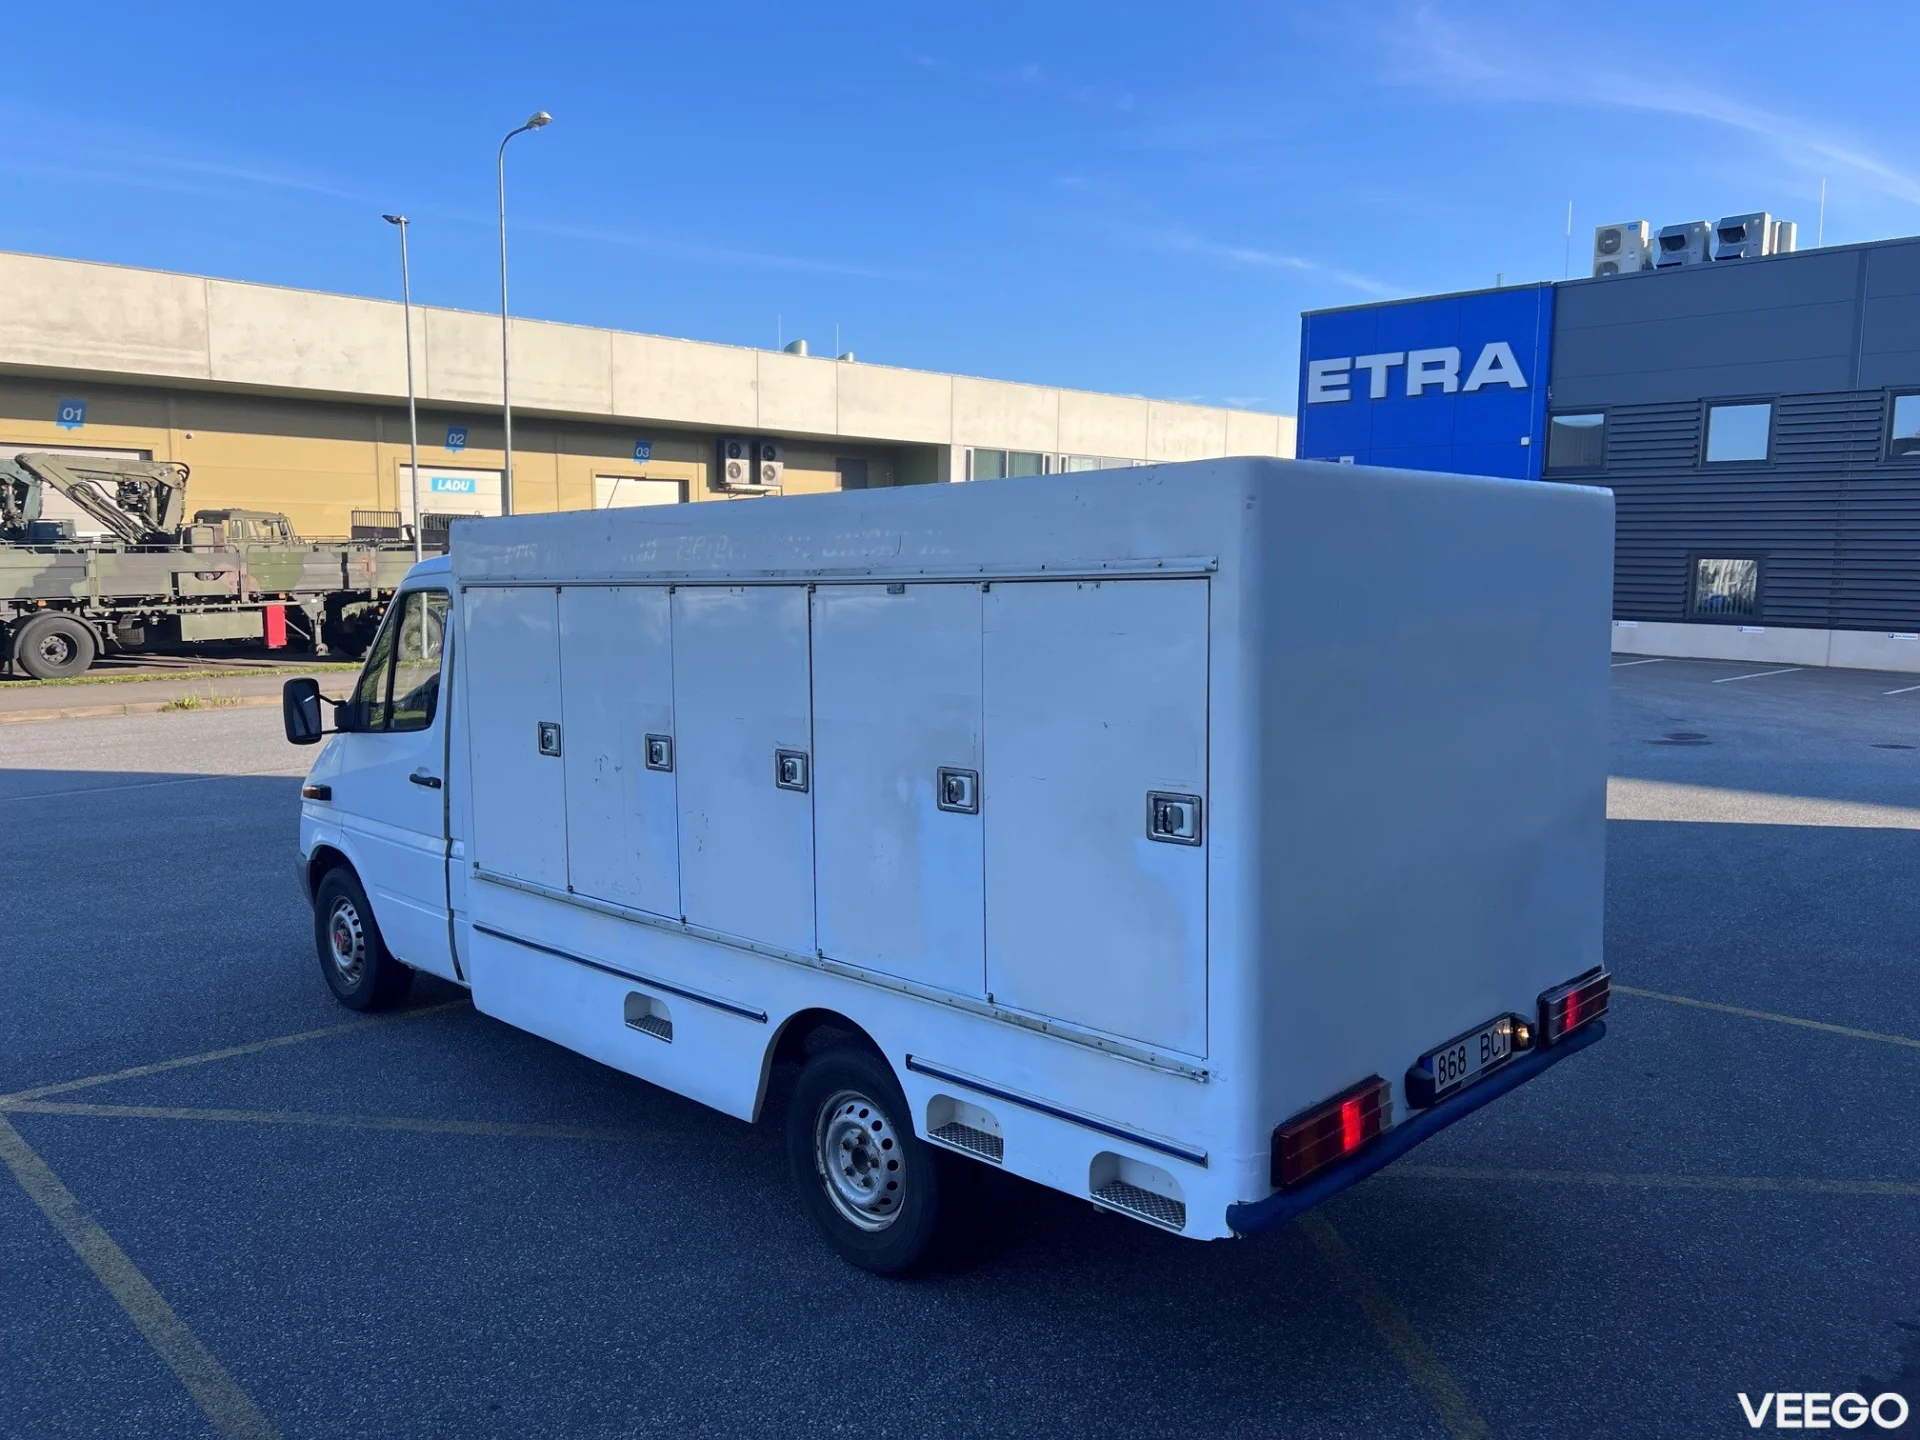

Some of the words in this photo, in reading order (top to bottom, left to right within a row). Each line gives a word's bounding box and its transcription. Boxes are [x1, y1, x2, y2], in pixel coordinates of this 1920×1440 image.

[1307, 341, 1528, 404] ETRA
[62, 407, 83, 421] 01
[448, 433, 465, 445] 02
[636, 446, 650, 458] 03
[437, 479, 471, 491] LADU
[1438, 1044, 1467, 1086] 868
